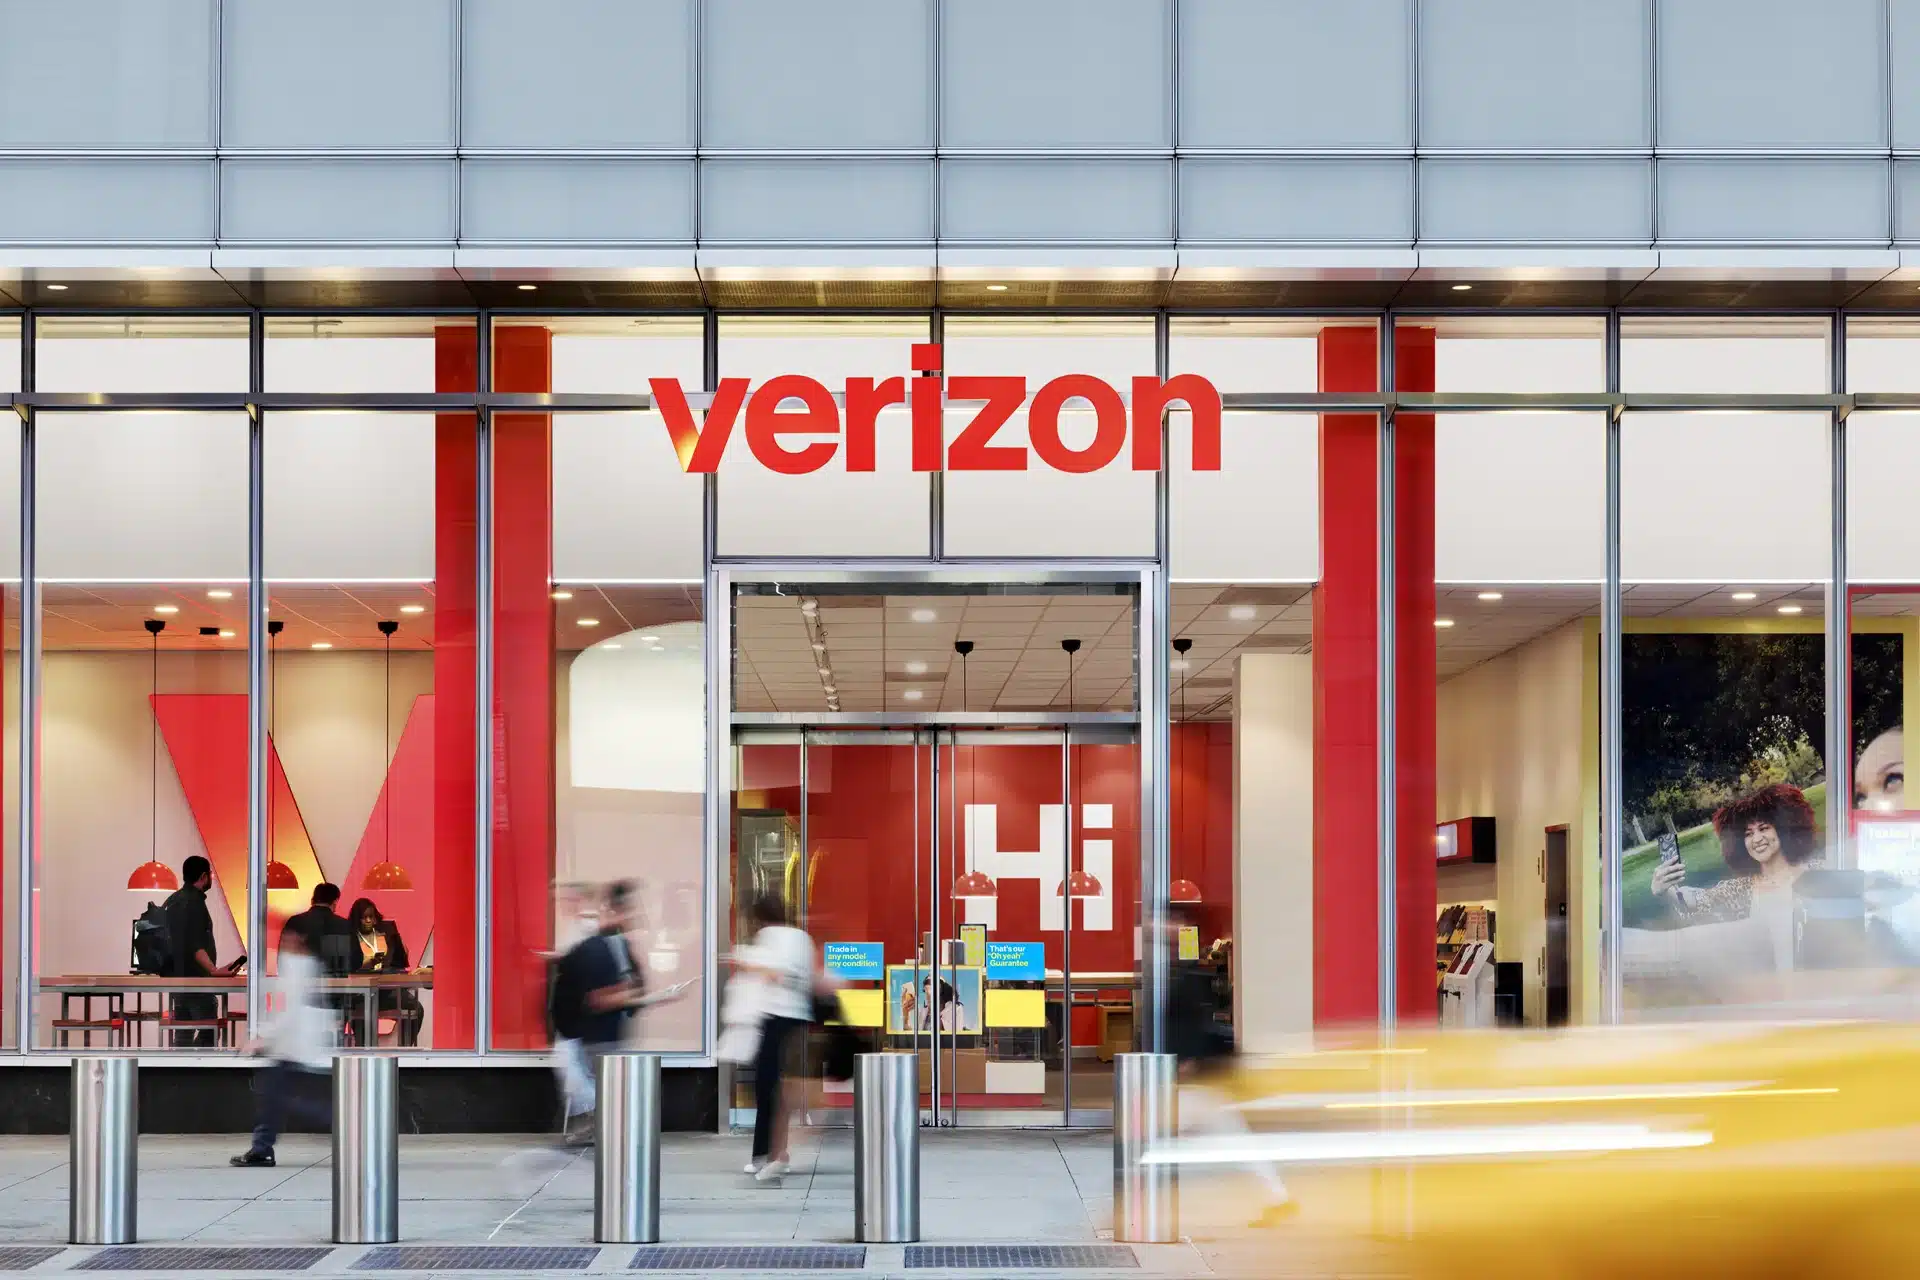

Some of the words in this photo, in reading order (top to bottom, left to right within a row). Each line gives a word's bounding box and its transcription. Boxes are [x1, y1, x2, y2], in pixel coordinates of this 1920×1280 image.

[648, 344, 1222, 474] verizon
[964, 804, 1113, 931] Hi
[828, 945, 849, 953] Trade
[850, 945, 858, 953] in
[990, 945, 1012, 953] That's
